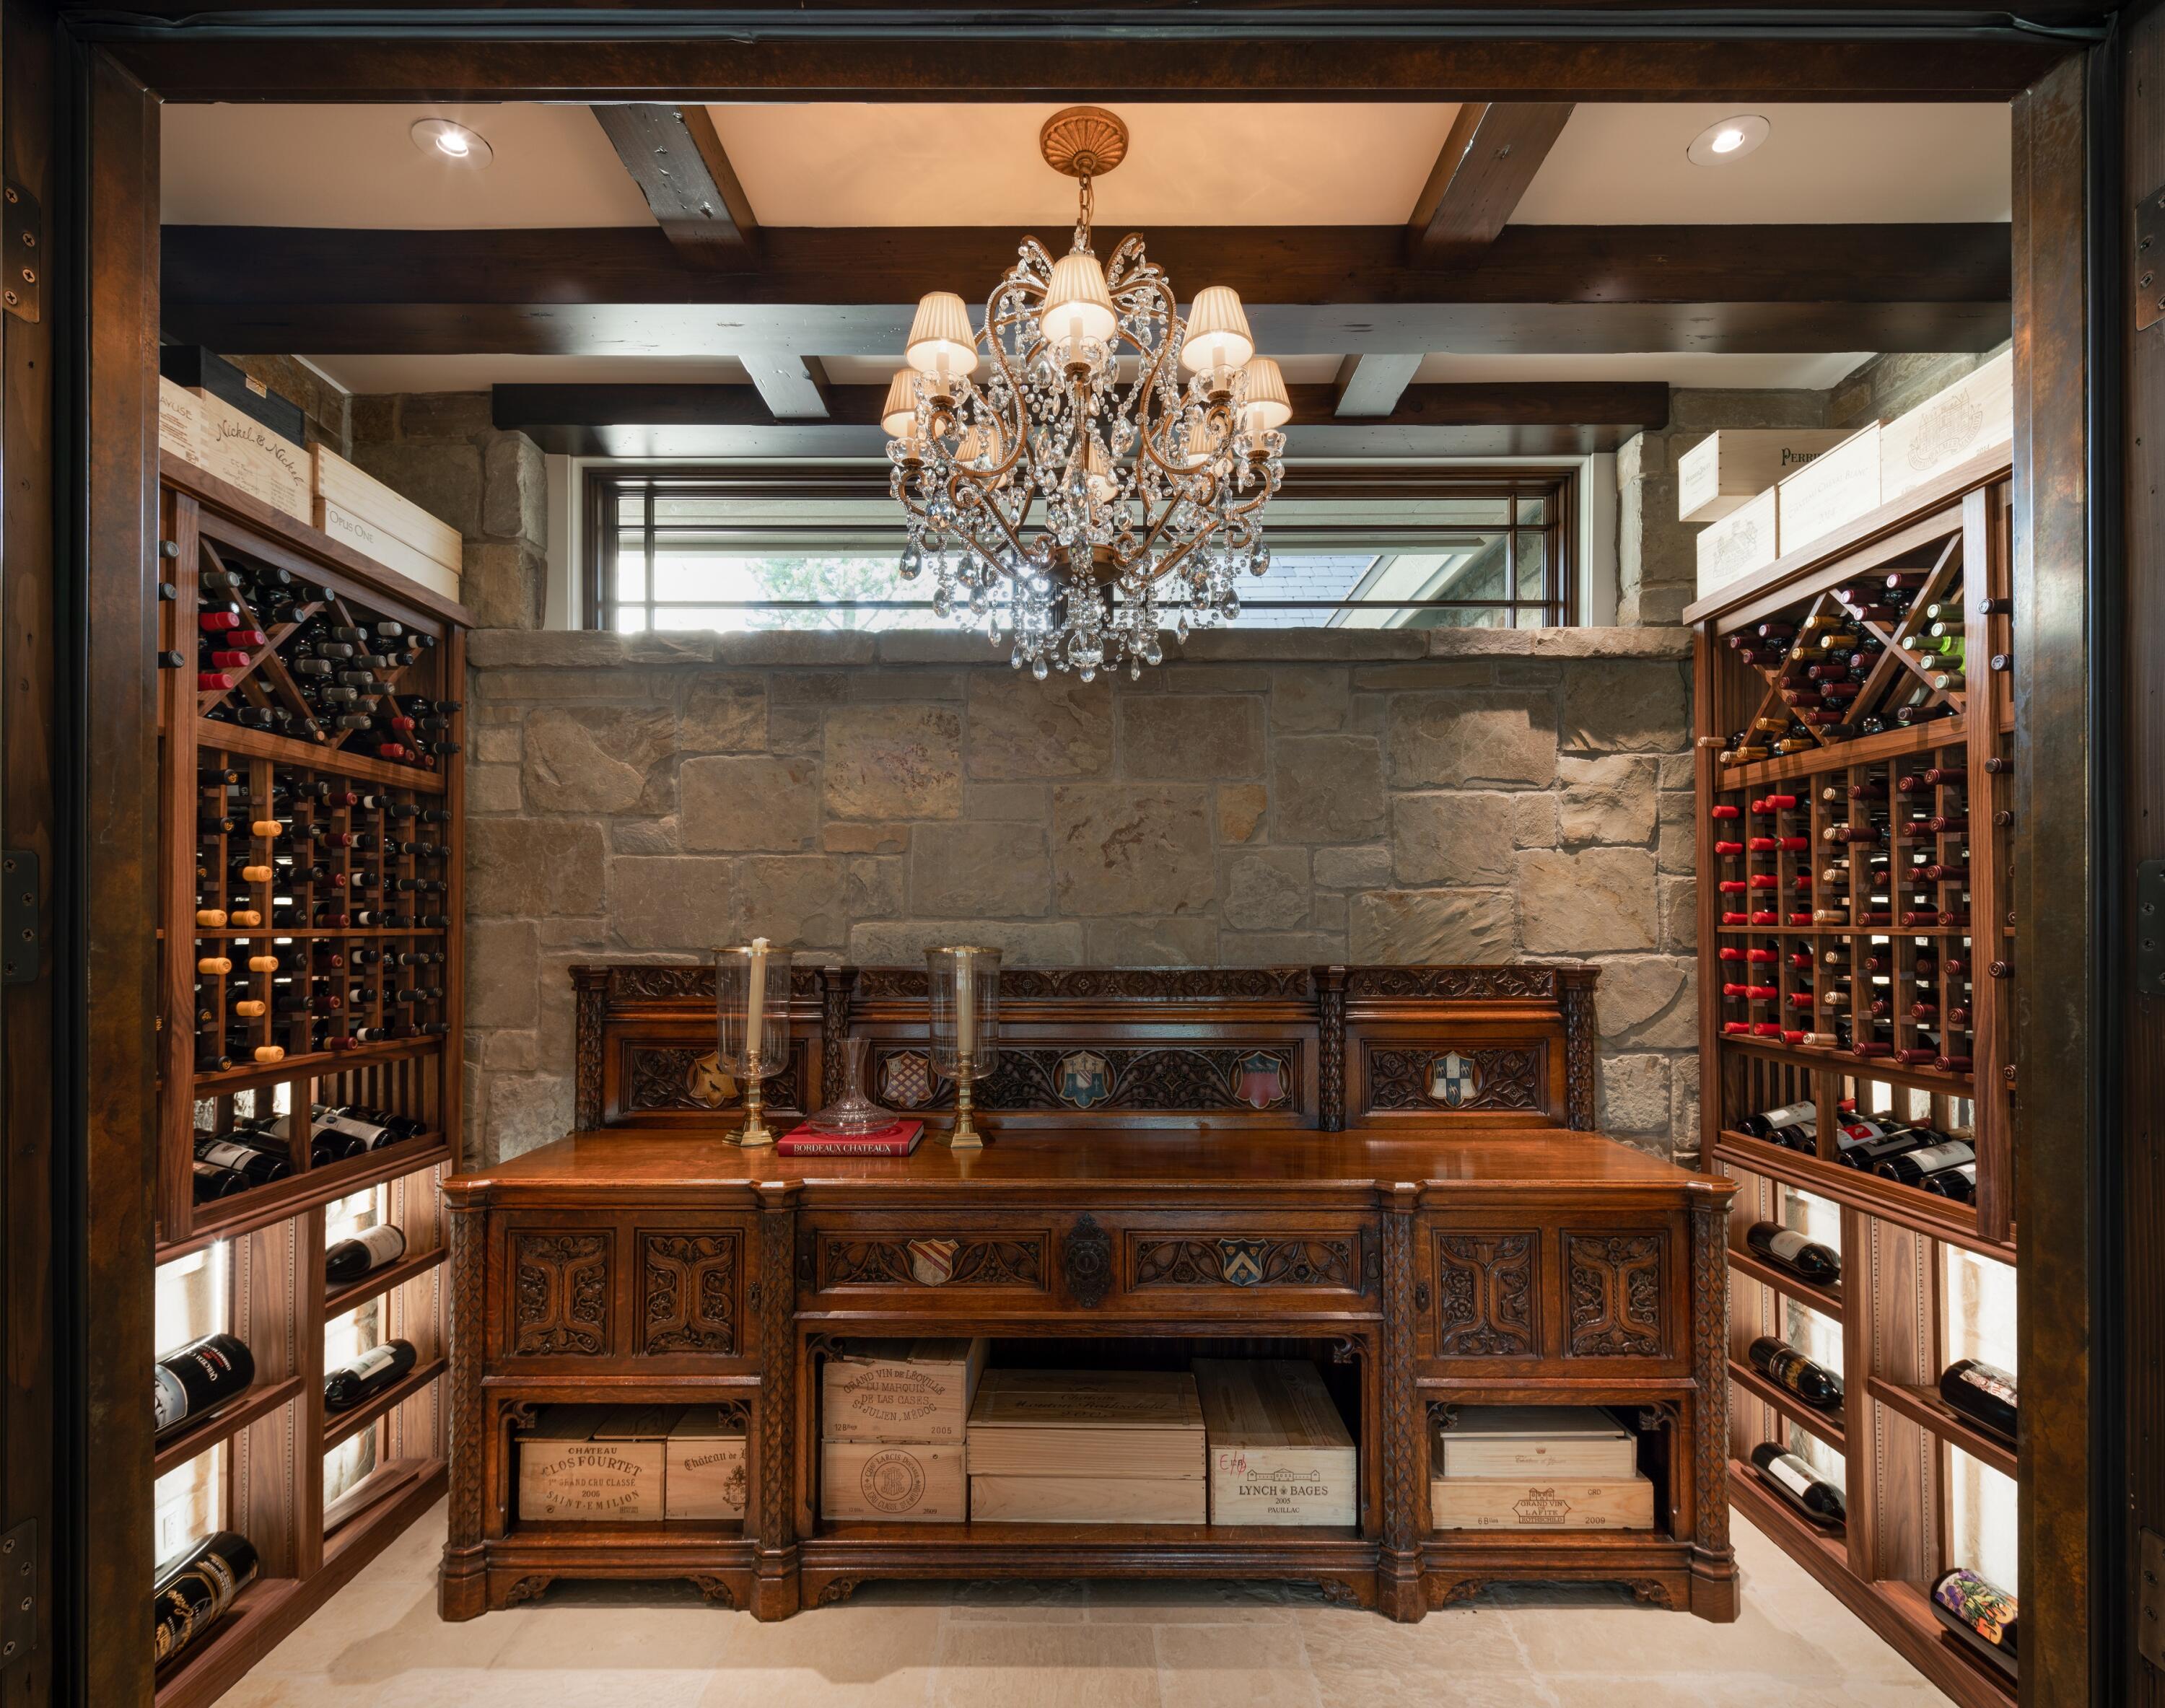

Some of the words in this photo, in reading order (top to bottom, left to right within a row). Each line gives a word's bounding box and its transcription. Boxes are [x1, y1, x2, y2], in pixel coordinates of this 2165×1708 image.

[160, 396, 193, 421] AYUSE
[216, 420, 255, 442] Nickel
[256, 434, 266, 446] &
[266, 444, 305, 486] Nickel
[1782, 448, 1823, 466] PERRI
[330, 511, 353, 532] OPUS
[355, 525, 374, 543] ONE
[794, 1144, 841, 1152] BORDEAUX
[843, 1144, 891, 1152] CHATEAUX
[844, 1372, 874, 1394] GRAND
[876, 1369, 893, 1378] VIN
[906, 1370, 945, 1395] LÉOVILLE
[867, 1383, 878, 1391] DU
[881, 1383, 925, 1393] MARQUIS
[862, 1394, 873, 1403] DE
[898, 1396, 929, 1406] CASES
[542, 1458, 576, 1477] CLOS
[577, 1455, 642, 1477] FOURTET
[684, 1453, 727, 1471] Château
[876, 1453, 901, 1464] LARCIS
[1239, 1486, 1277, 1495] LYNCH
[1290, 1486, 1329, 1495] BAGES
